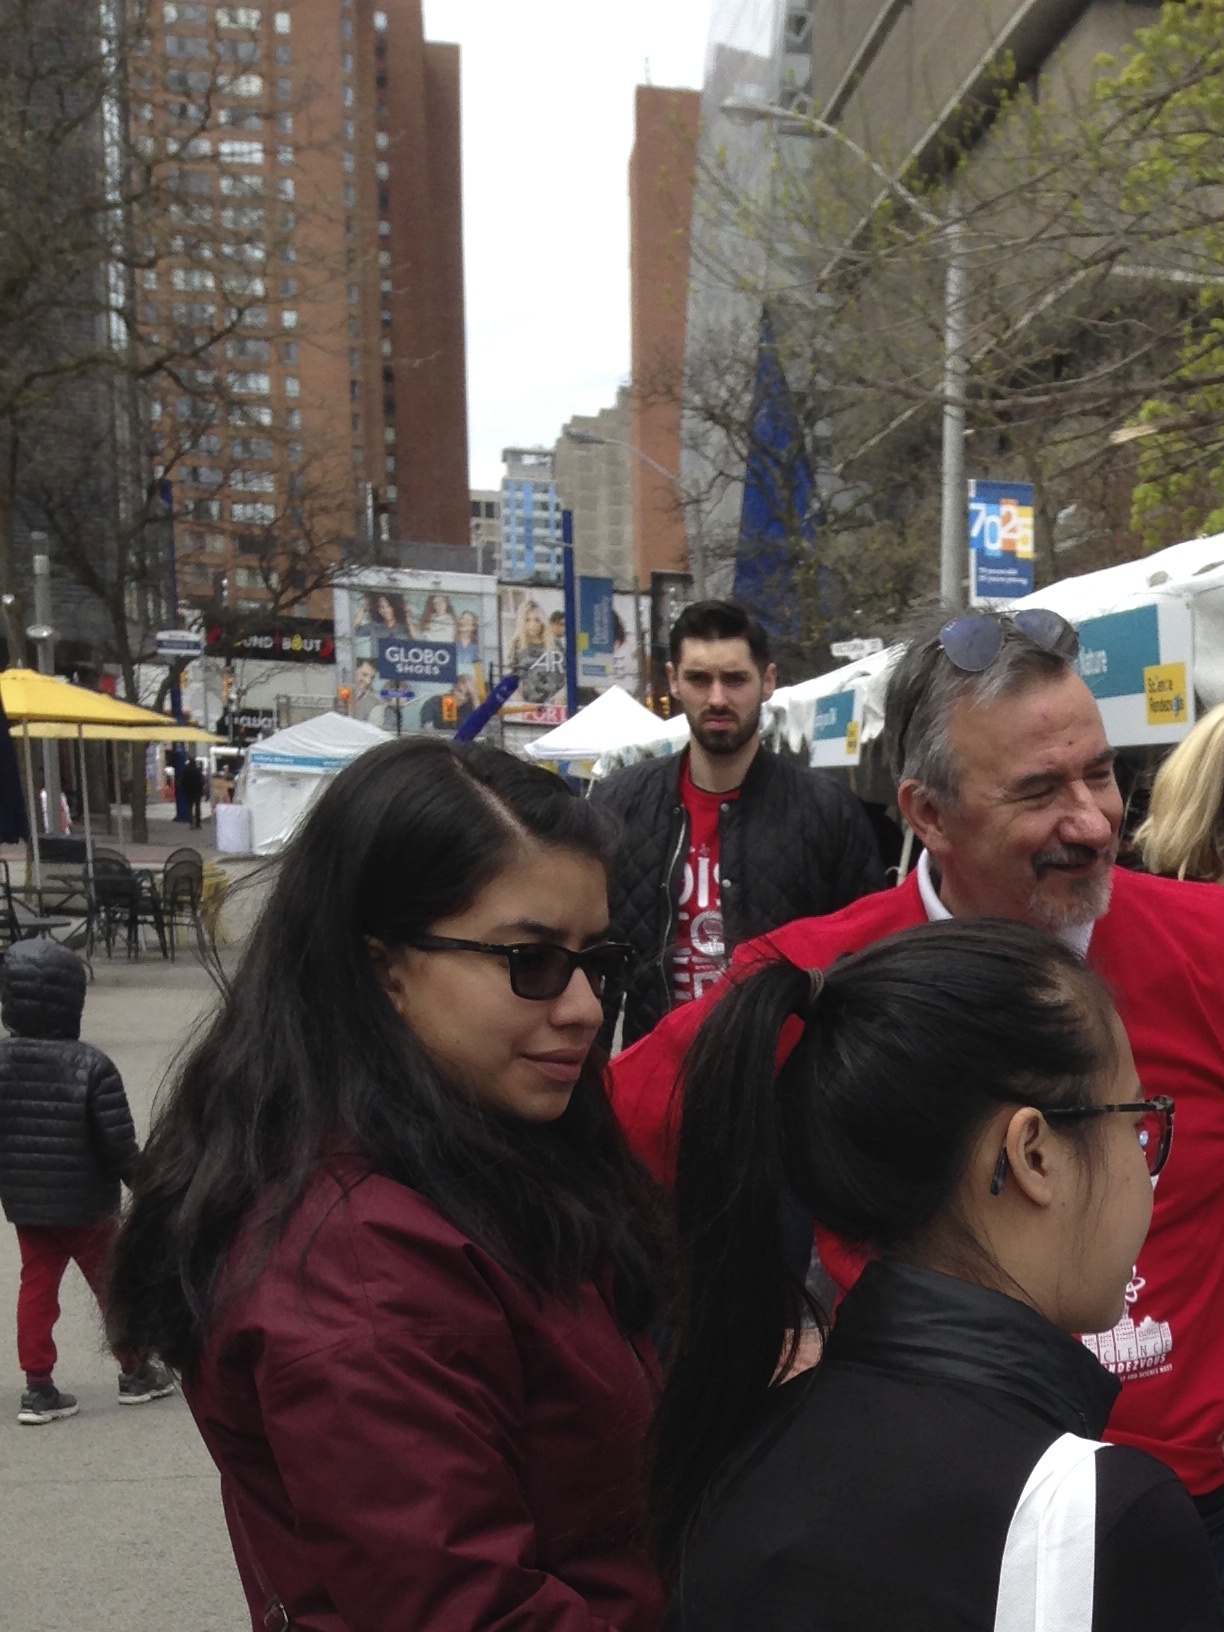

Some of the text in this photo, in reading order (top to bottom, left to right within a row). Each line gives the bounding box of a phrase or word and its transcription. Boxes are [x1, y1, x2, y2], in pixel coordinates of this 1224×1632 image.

[385, 646, 450, 666] GLOBO
[395, 662, 441, 676] SHOES
[1102, 1339, 1170, 1363] CIENCE
[1104, 1353, 1167, 1374] NDEZVOUS
